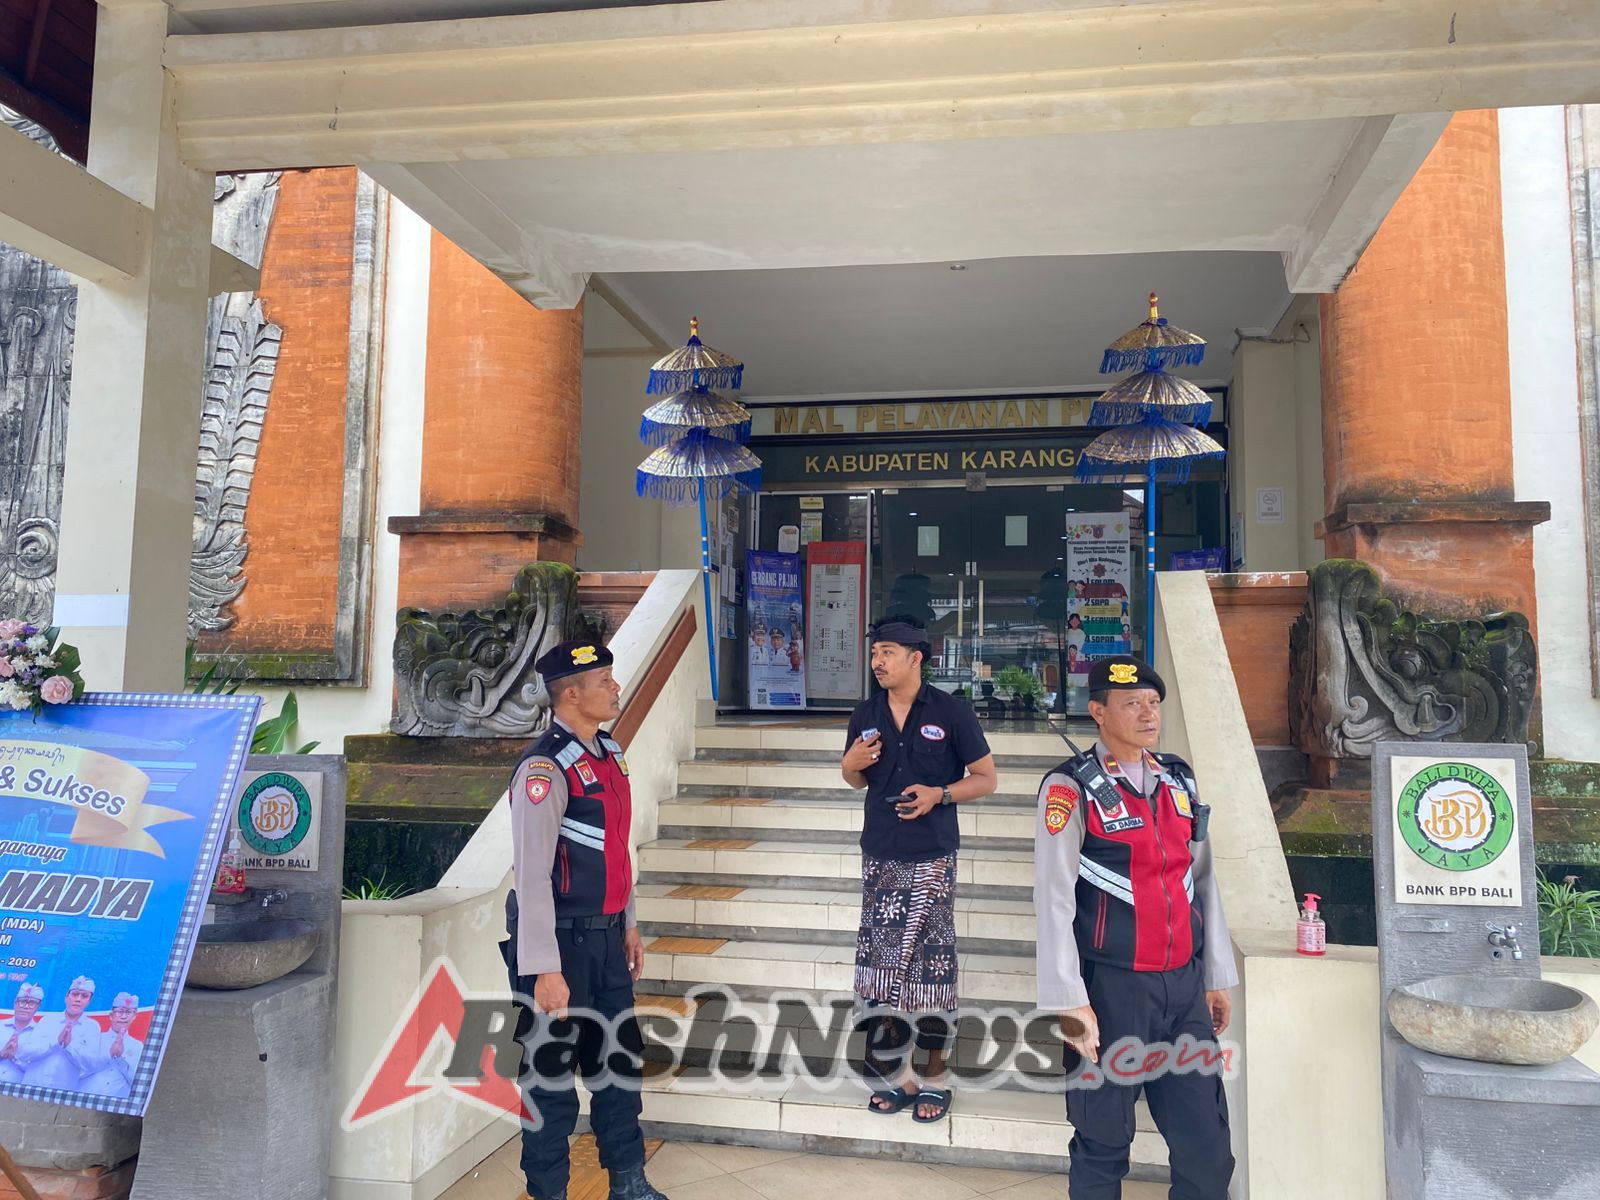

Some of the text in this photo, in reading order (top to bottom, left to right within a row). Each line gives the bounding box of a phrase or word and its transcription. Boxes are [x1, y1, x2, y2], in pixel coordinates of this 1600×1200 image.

[774, 405, 845, 434] MAL
[856, 398, 1049, 433] PELAYANAN
[804, 451, 950, 474] KABUPATEN
[1084, 598, 1091, 606] 2
[23, 767, 127, 816] Sukses
[1405, 765, 1500, 802] BALI DWIPA
[265, 858, 285, 868] BPD
[287, 859, 310, 868] BALI
[1418, 844, 1495, 867] JAYA
[0, 870, 154, 921] MADYA
[1406, 885, 1513, 898] BANK BPD BALI
[2, 917, 45, 933] (MDA)
[8, 957, 36, 968] 2030
